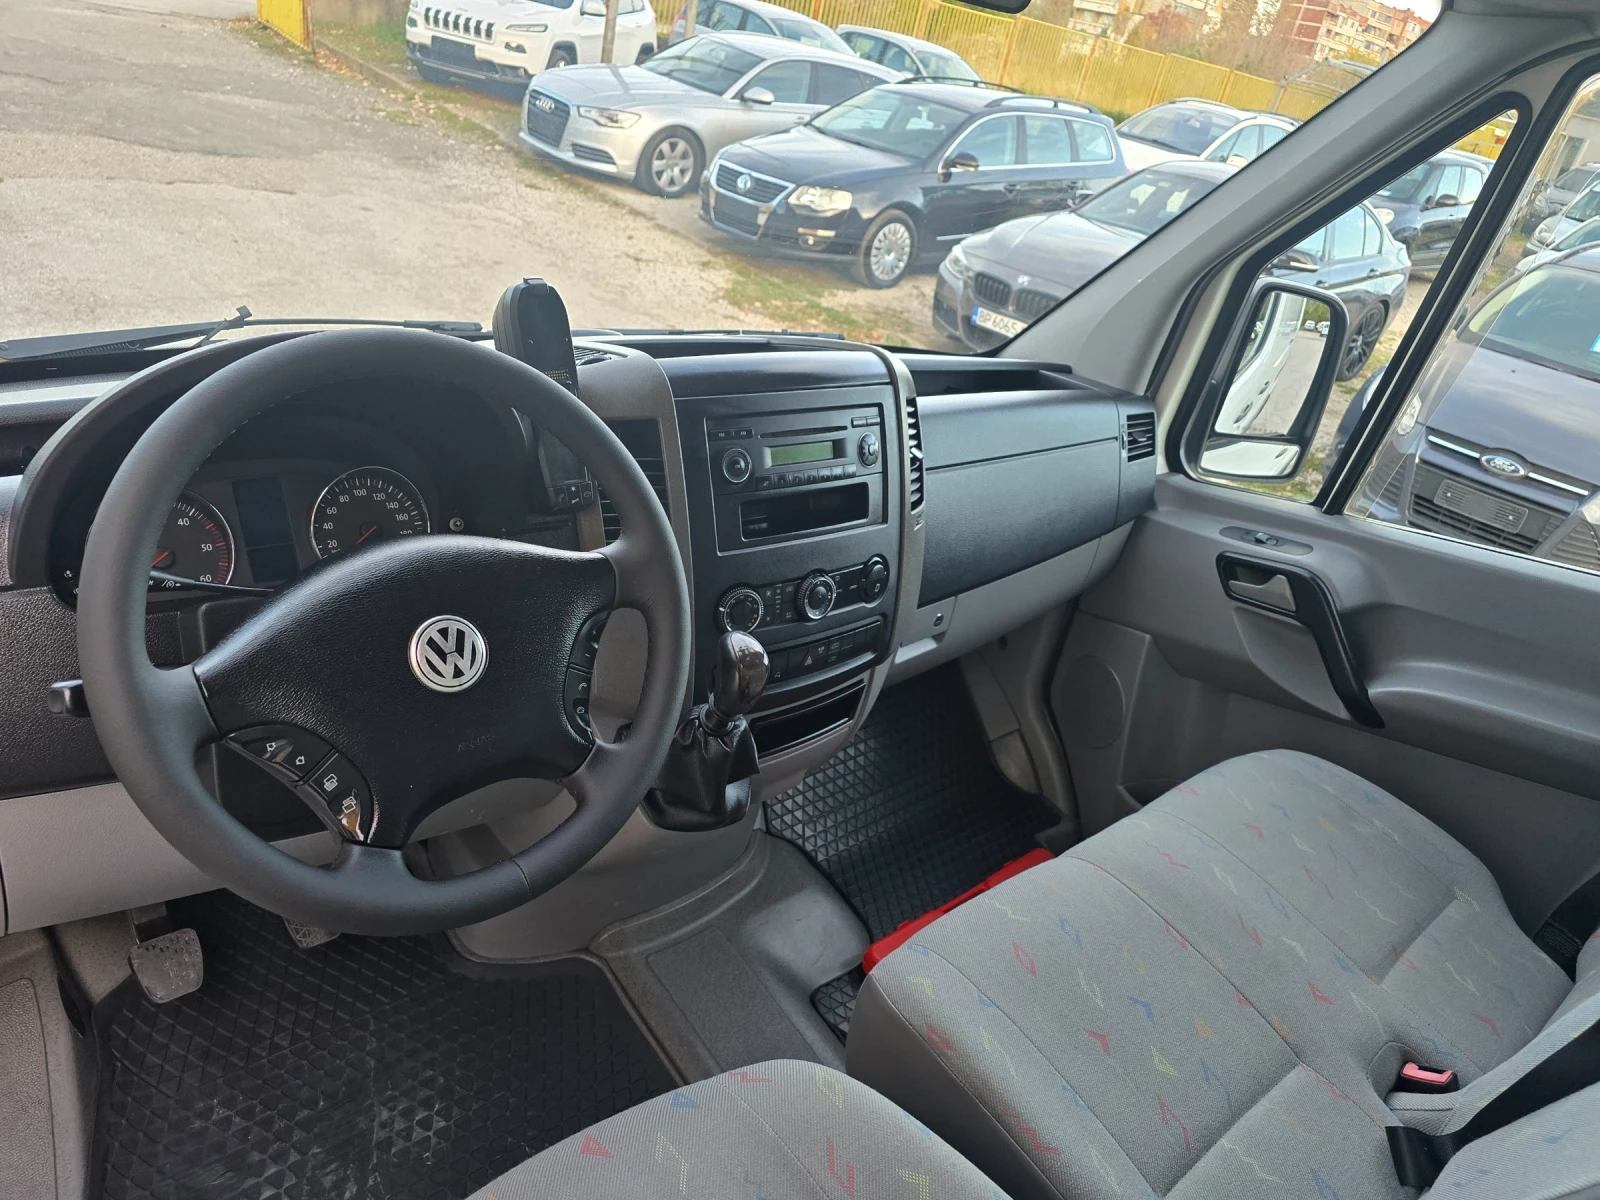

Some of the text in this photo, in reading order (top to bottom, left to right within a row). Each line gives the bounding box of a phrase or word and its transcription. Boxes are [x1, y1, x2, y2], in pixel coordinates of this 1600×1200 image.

[353, 488, 367, 496] 100
[373, 492, 386, 501] 120
[339, 494, 350, 503] 80
[386, 501, 399, 509] 140
[326, 506, 337, 515] 60
[395, 513, 409, 521] 160
[177, 517, 190, 527] 40
[323, 522, 333, 530] 40
[201, 543, 213, 552] 50
[327, 539, 338, 548] 20
[200, 574, 212, 582] 60
[413, 618, 485, 690] VW
